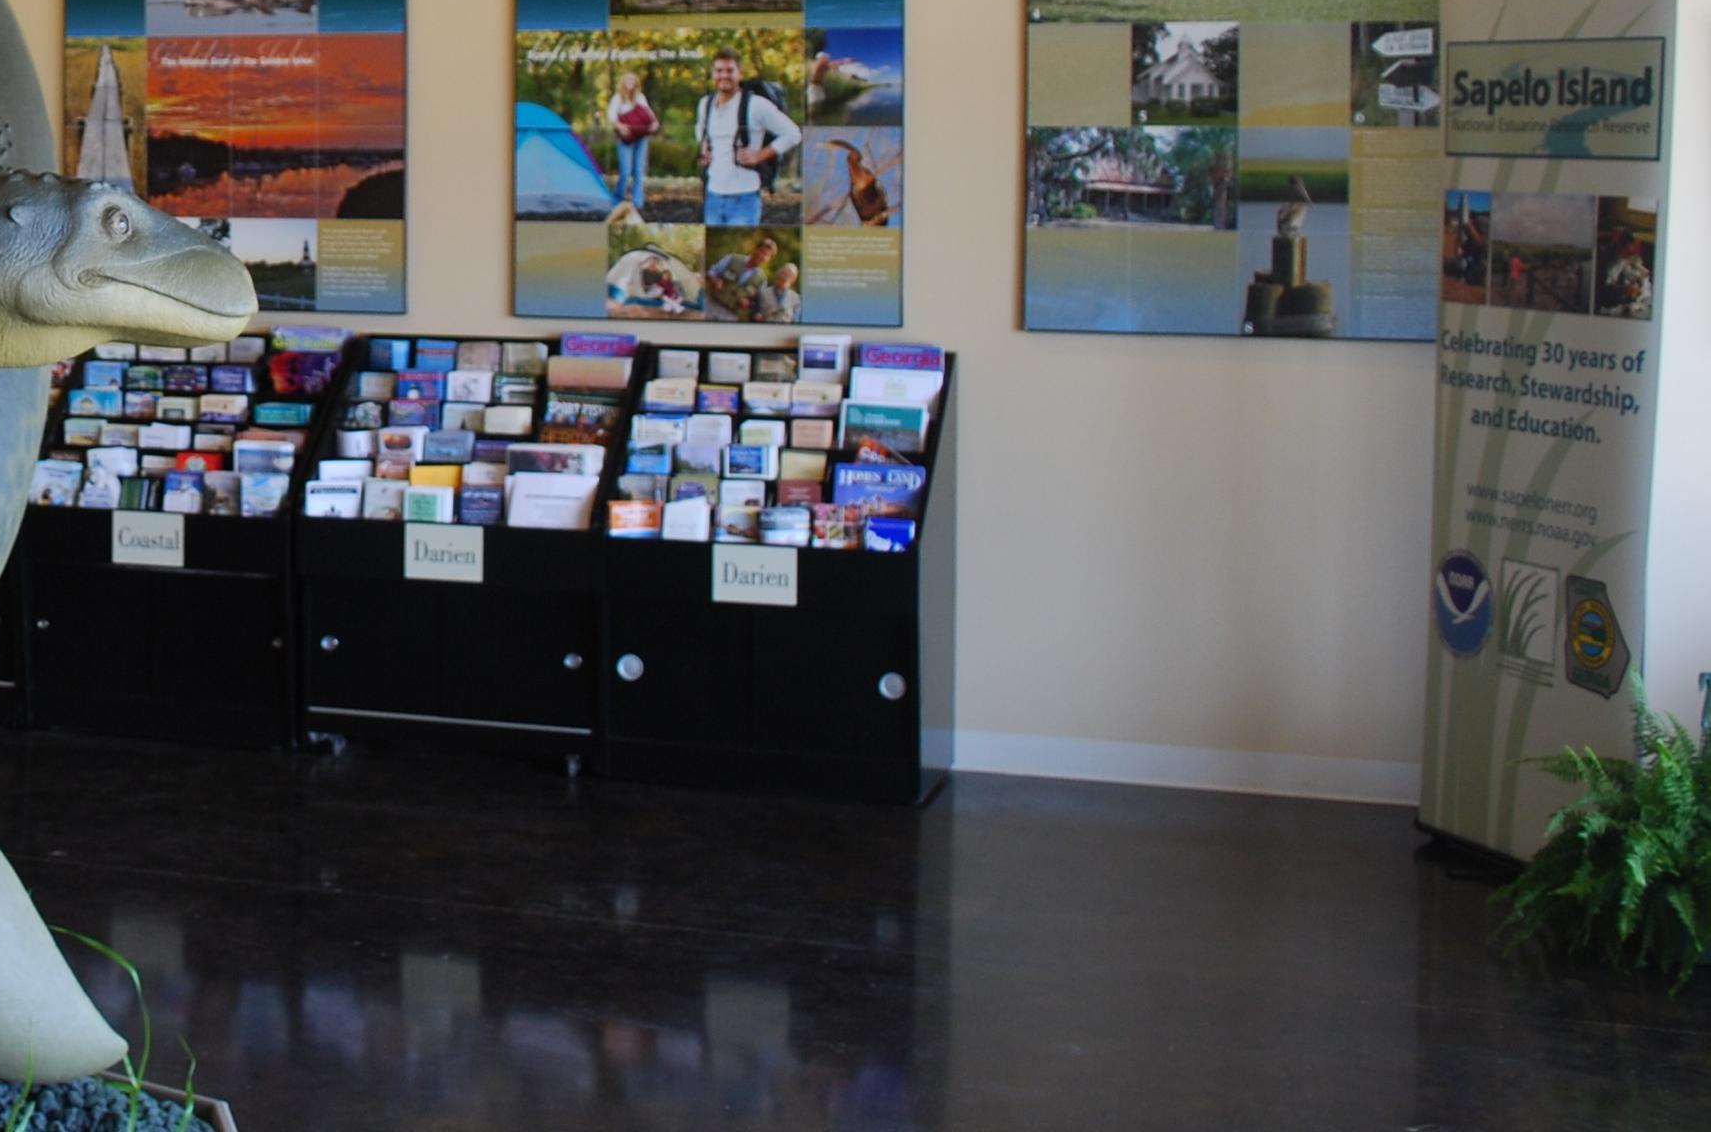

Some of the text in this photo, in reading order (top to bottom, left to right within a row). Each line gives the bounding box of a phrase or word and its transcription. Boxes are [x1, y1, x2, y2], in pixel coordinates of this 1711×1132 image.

[1453, 69, 1552, 116] Sapelo
[1557, 66, 1653, 107] Island
[1602, 118, 1651, 134] Reserve
[867, 347, 942, 368] Georgia
[1441, 329, 1646, 373] Celebrating 30 years of
[1440, 364, 1640, 416] Research, Stewardship,
[1471, 406, 1601, 444] and Education.
[118, 527, 180, 549] Coastal
[414, 539, 476, 564] Darien
[722, 561, 789, 587] Darien
